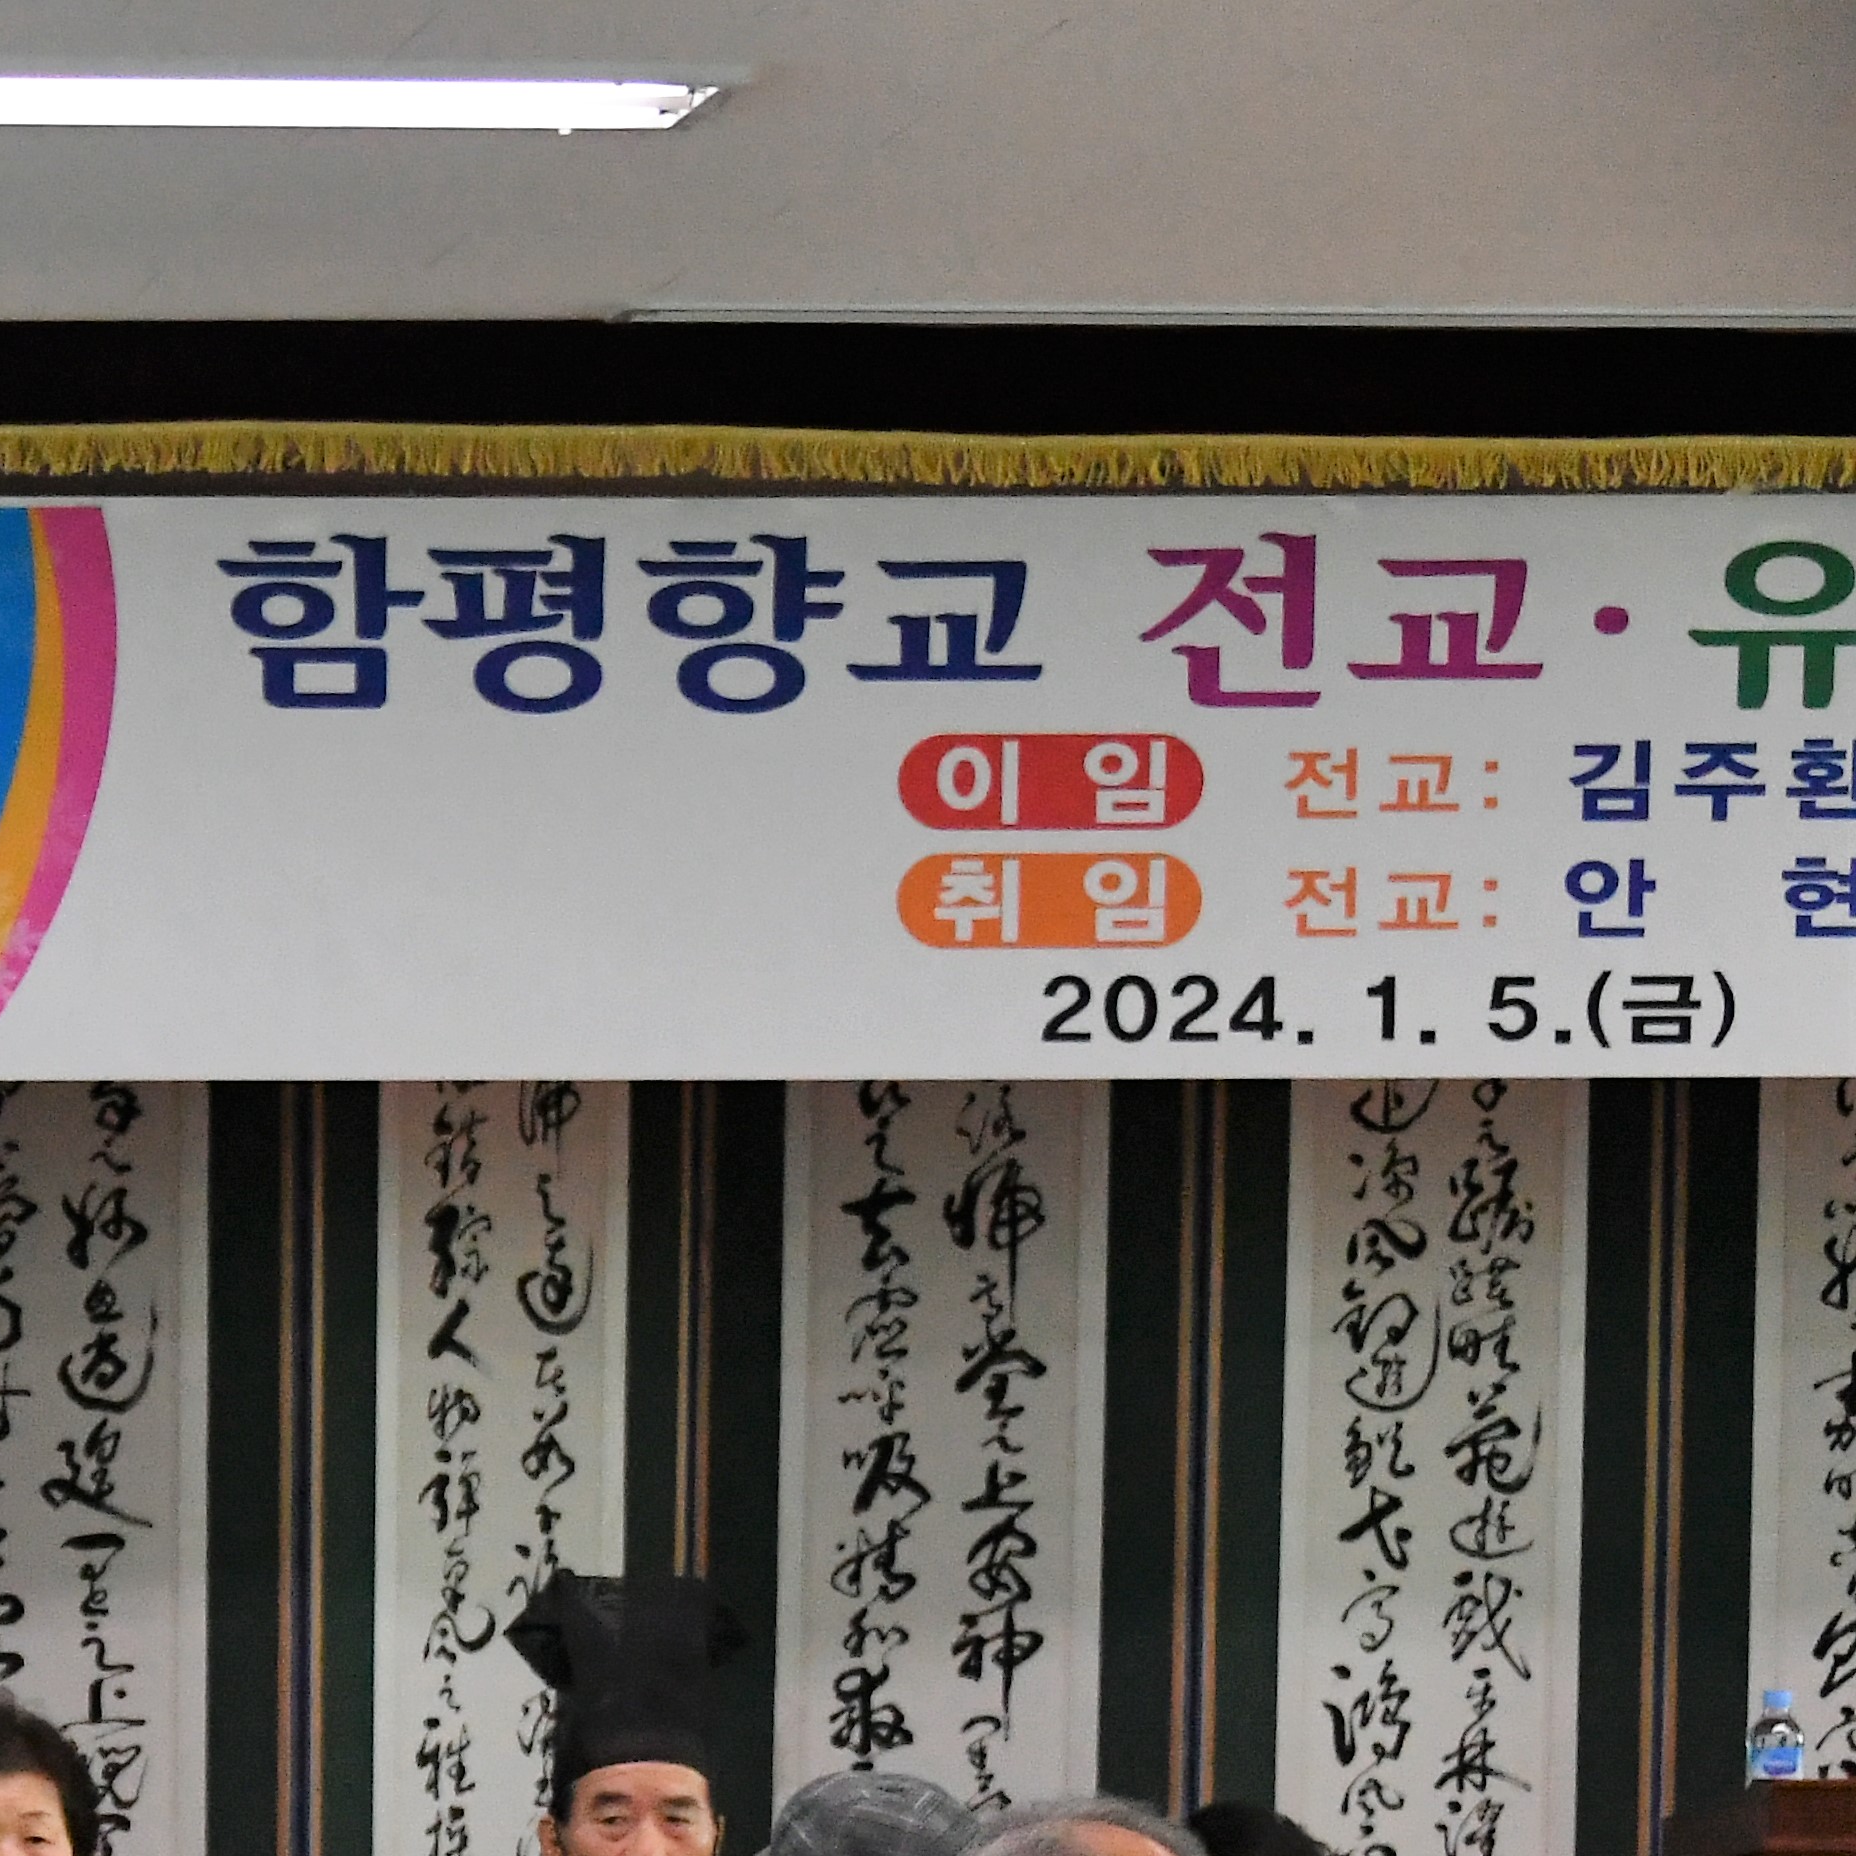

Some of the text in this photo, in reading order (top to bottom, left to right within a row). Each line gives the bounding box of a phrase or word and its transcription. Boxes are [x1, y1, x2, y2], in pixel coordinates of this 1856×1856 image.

[216, 532, 1043, 714] 함평향교
[1285, 748, 1501, 821] 전교:
[1285, 867, 1500, 938] 전교:
